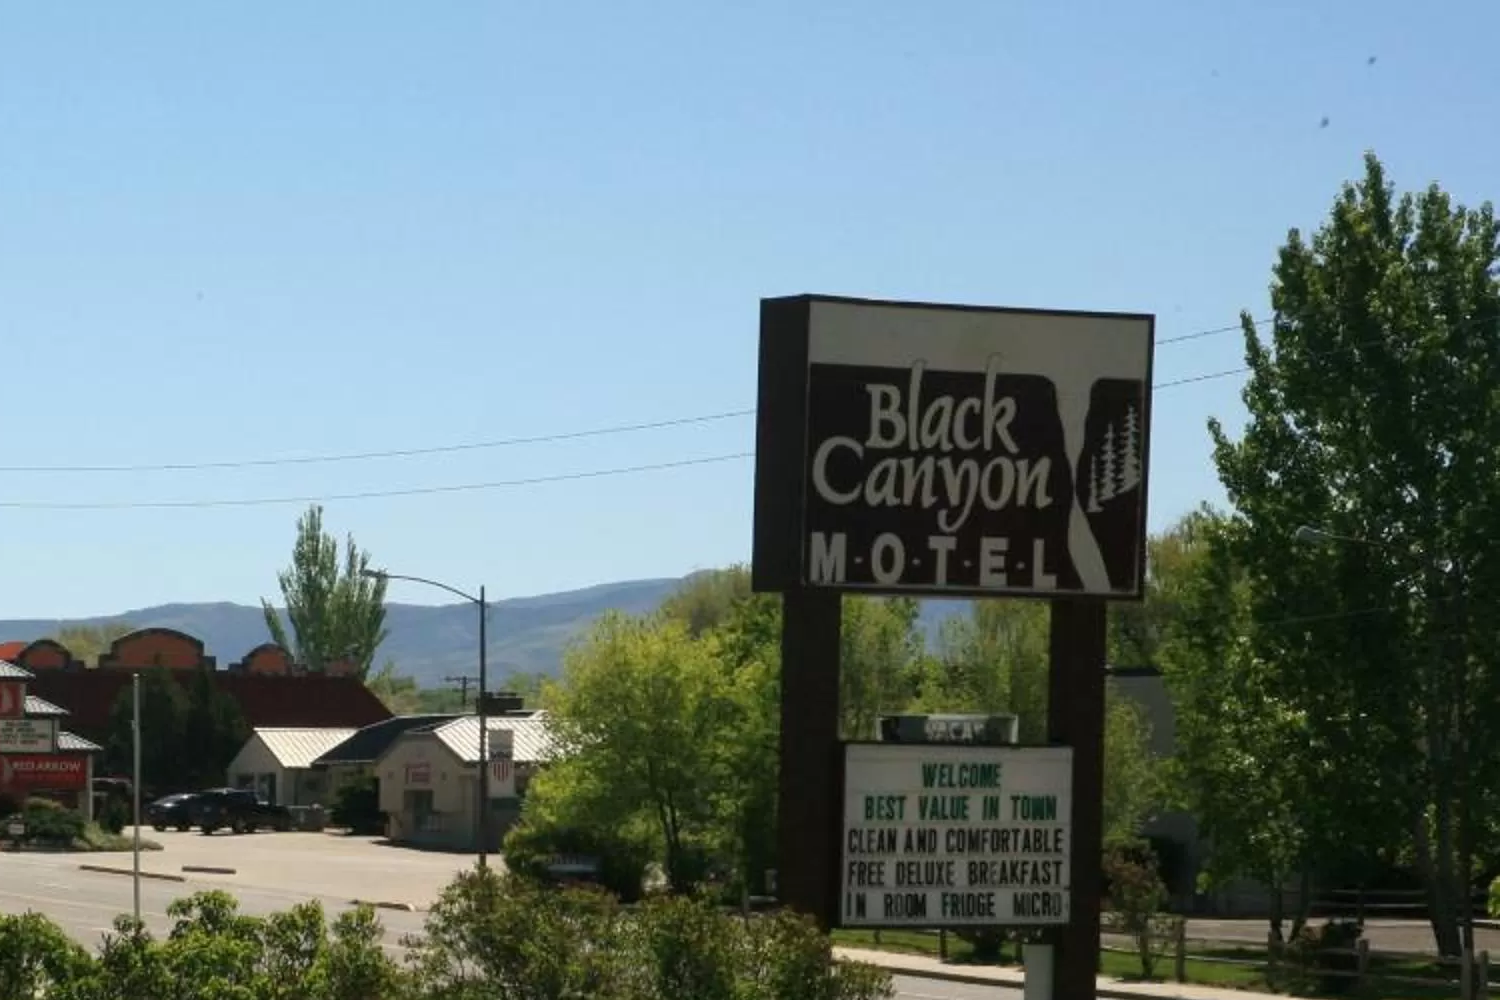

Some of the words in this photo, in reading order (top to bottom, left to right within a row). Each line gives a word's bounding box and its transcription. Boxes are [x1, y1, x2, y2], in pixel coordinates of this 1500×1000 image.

[865, 352, 1020, 454] Black
[812, 436, 1053, 532] Canyon
[921, 763, 1002, 789] WELCOME
[864, 794, 907, 821] BEST
[918, 795, 970, 821] VALUE
[982, 794, 1000, 821] IN
[1010, 794, 1057, 821] TOWN
[847, 827, 897, 853] CLEAN
[903, 828, 937, 853] AND
[945, 828, 1064, 853] COMFORTABLE
[847, 860, 885, 886] FREE
[895, 860, 955, 886] DELUXE
[967, 860, 1063, 886] BREAKFAST
[846, 891, 867, 918] IN
[883, 892, 927, 918] ROOM
[941, 891, 997, 917] FRIDGE
[1012, 892, 1063, 917] MICRO
